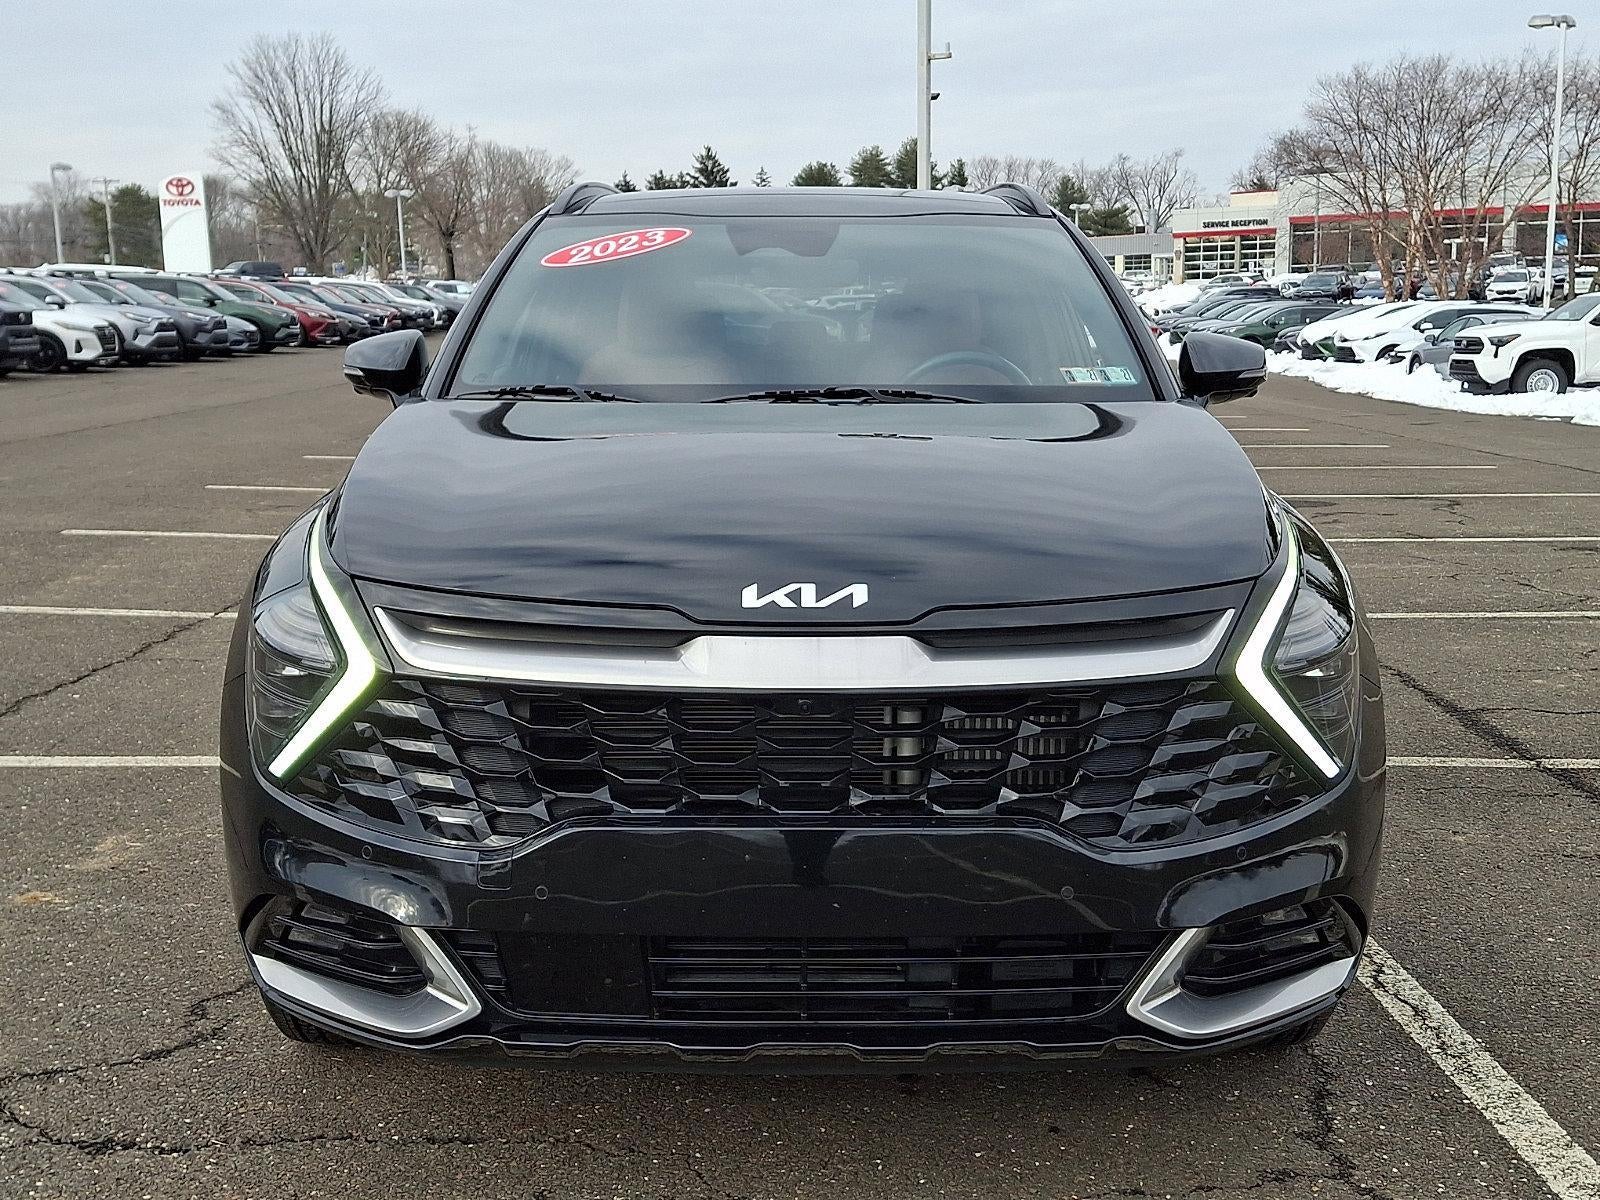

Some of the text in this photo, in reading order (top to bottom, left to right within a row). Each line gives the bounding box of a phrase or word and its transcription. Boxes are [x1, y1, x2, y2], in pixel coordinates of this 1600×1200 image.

[161, 198, 201, 207] TOYOTA
[1202, 218, 1269, 229] SERVICE RECEPTION
[568, 230, 666, 264] 2023
[741, 582, 869, 609] KIA
